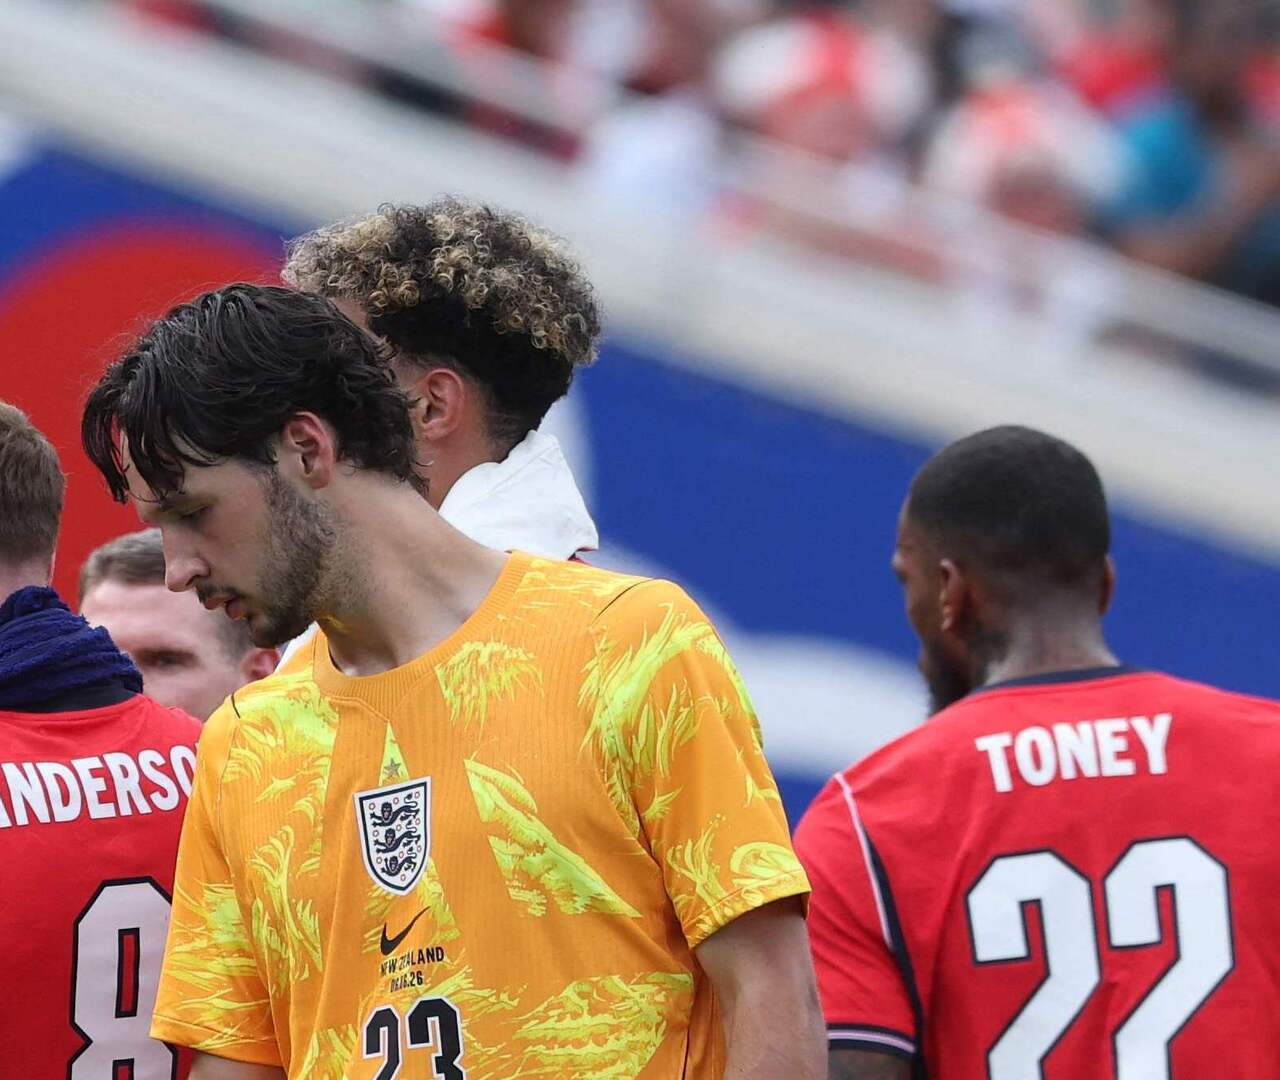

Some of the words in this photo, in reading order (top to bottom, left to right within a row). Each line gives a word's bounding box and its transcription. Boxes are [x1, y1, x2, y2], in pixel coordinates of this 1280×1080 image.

[975, 714, 1173, 793] TONEY
[381, 957, 397, 976] NEW
[399, 946, 445, 970] ZEALAND
